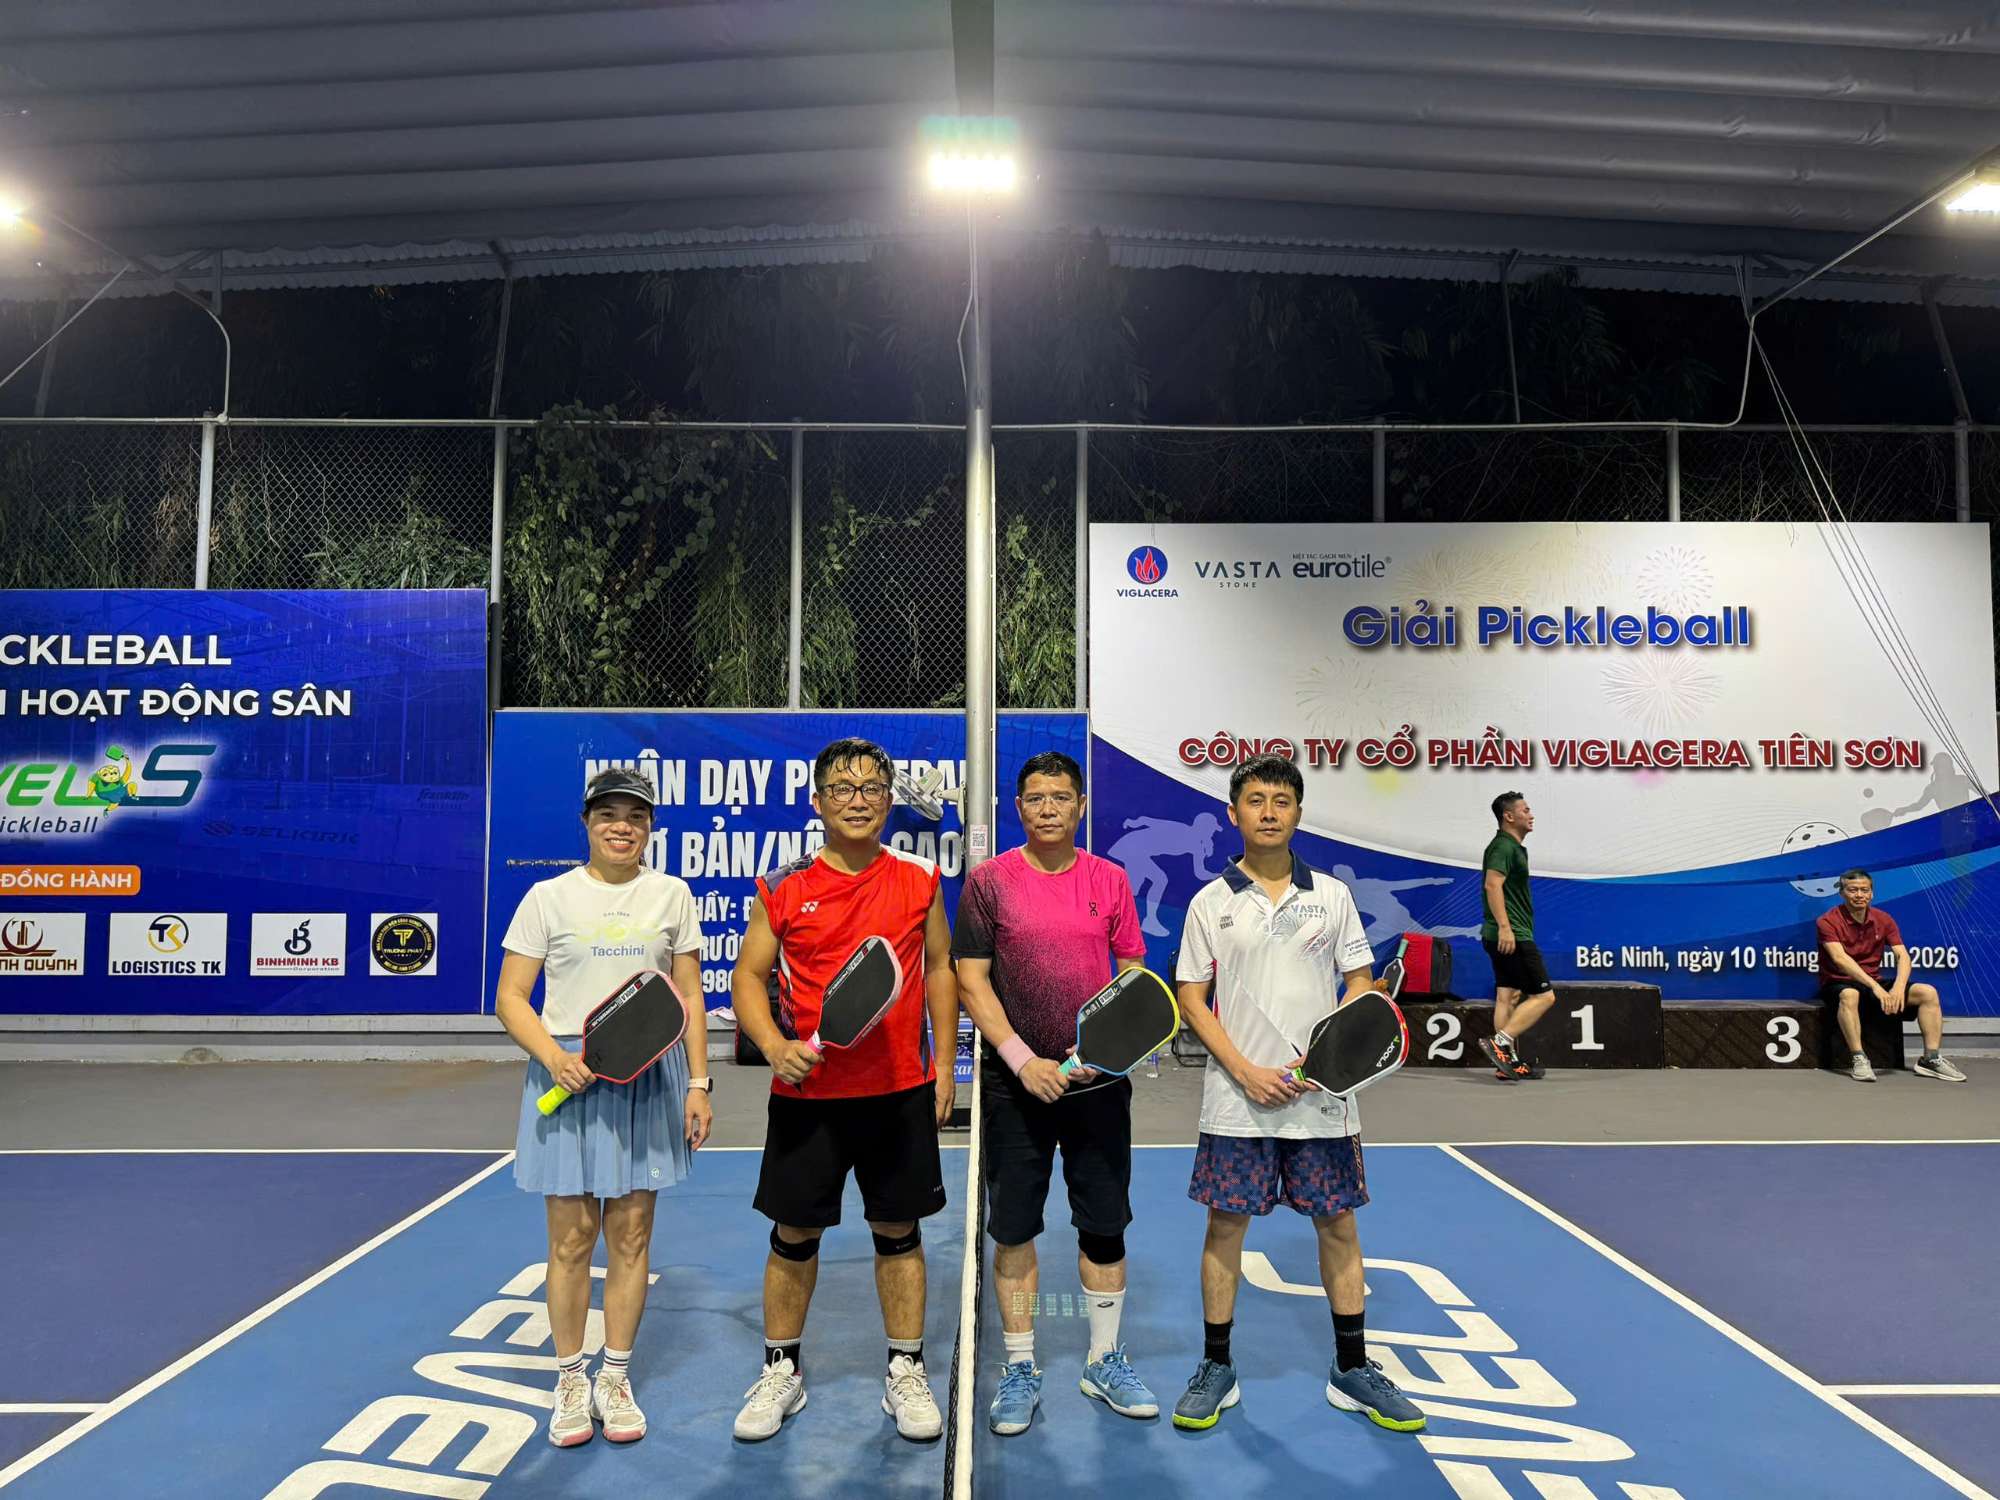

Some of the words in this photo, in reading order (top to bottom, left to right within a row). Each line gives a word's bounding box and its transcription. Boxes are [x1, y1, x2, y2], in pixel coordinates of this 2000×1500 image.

[1194, 561, 1281, 578] VASTA
[1116, 588, 1179, 598] VIGLACERA
[1342, 599, 1456, 647] Giải
[1477, 606, 1751, 647] Pickleball
[20, 688, 131, 722] HOẠT
[139, 682, 260, 722] ĐỘNG
[271, 682, 351, 717] SÂN
[1178, 730, 1294, 767] CÔNG
[1303, 738, 1344, 766] TY
[1356, 723, 1416, 767] CỔ
[1426, 725, 1531, 767] PHẦN
[1541, 738, 1751, 768] VIGLACERA
[1758, 731, 1834, 768] TIÊN
[1842, 735, 1922, 768] SƠN
[700, 759, 773, 815] DẠY
[0, 867, 64, 888] ĐỒNG
[70, 868, 132, 888] HÀNH
[1290, 903, 1328, 915] VASTA
[256, 958, 318, 967] BINHMINH
[321, 958, 339, 967] KB
[591, 945, 645, 957] Tacchini
[1575, 946, 1614, 968] Bắc
[1621, 947, 1669, 972] Ninh,
[1677, 947, 1724, 973] ngày
[1731, 947, 1757, 968] 10
[1763, 947, 1820, 973] tháng
[1909, 946, 1959, 969] 2026
[112, 960, 196, 974] LOGISTICS
[202, 960, 221, 974] TK
[1426, 1012, 1465, 1061] 2
[1570, 1004, 1606, 1051] 1
[1765, 1016, 1801, 1064] 3
[1375, 1041, 1395, 1068] JOOLA
